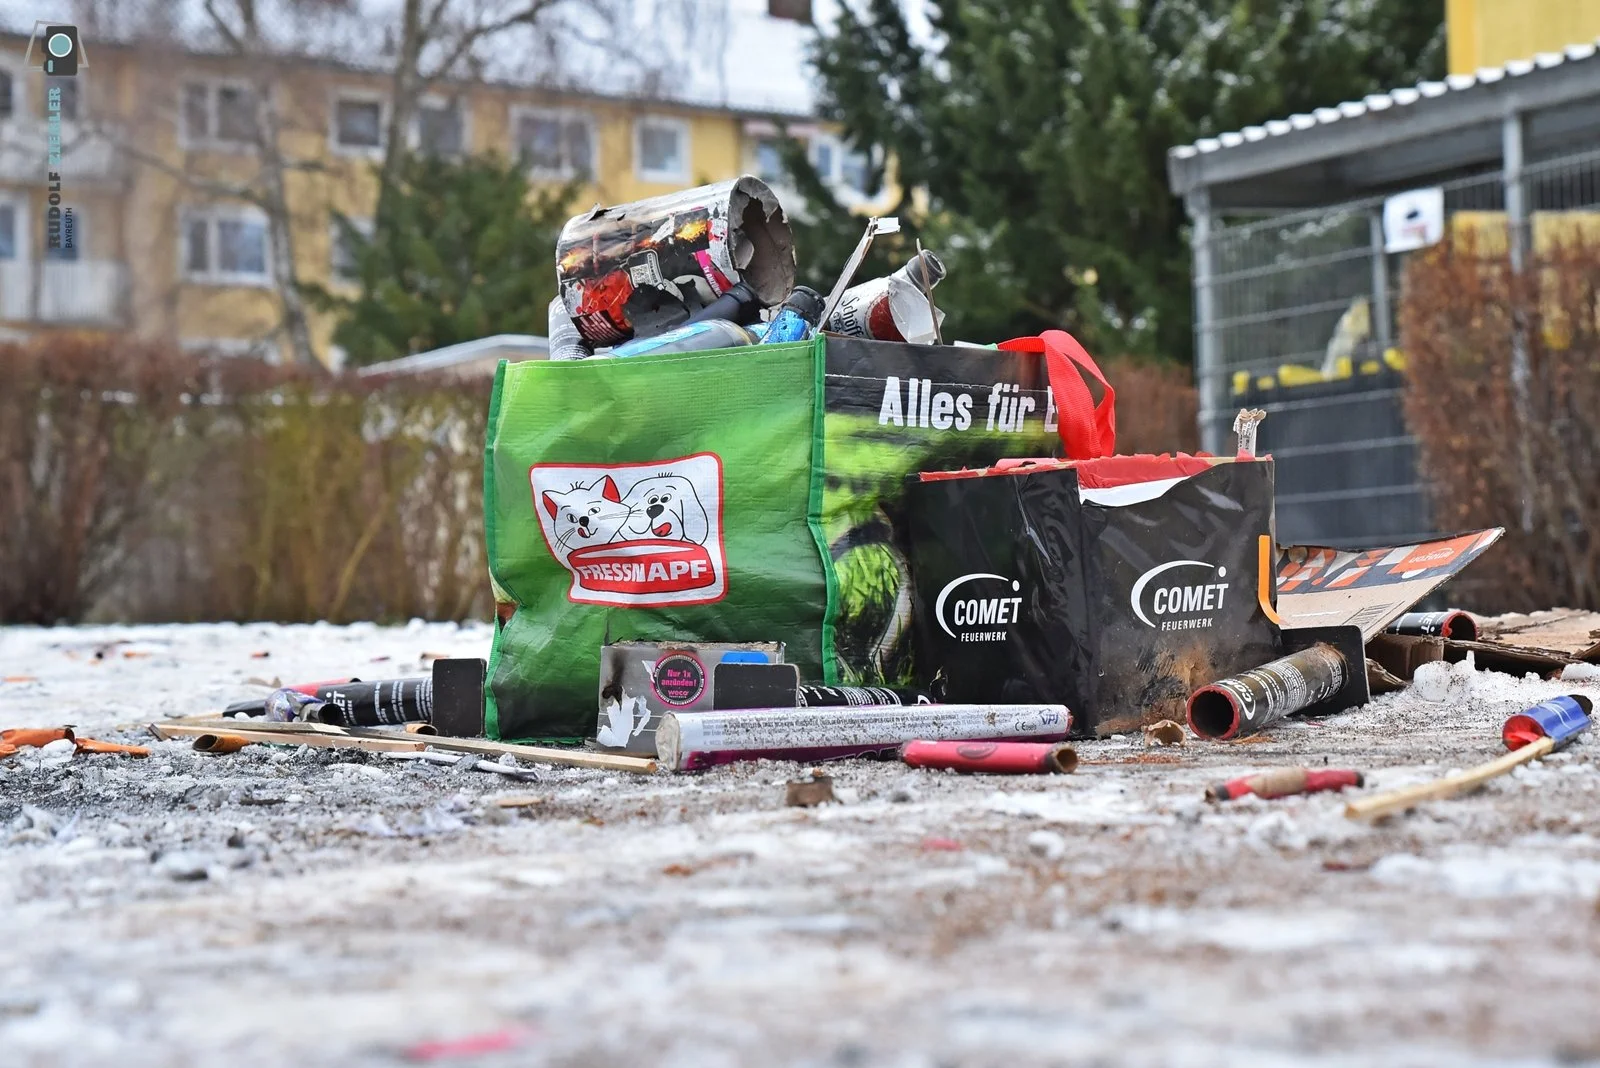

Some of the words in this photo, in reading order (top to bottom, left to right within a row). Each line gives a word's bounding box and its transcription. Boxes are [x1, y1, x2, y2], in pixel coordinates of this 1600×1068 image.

[878, 376, 973, 432] Alles
[986, 382, 1036, 433] für
[576, 559, 708, 583] FRESSNAPF
[1153, 583, 1229, 615] COMET
[954, 597, 1023, 626] COMET
[960, 631, 1008, 642] FEUERWERK
[1161, 617, 1214, 632] FEUERWERK
[667, 669, 681, 677] Nur
[683, 670, 692, 678] 1x
